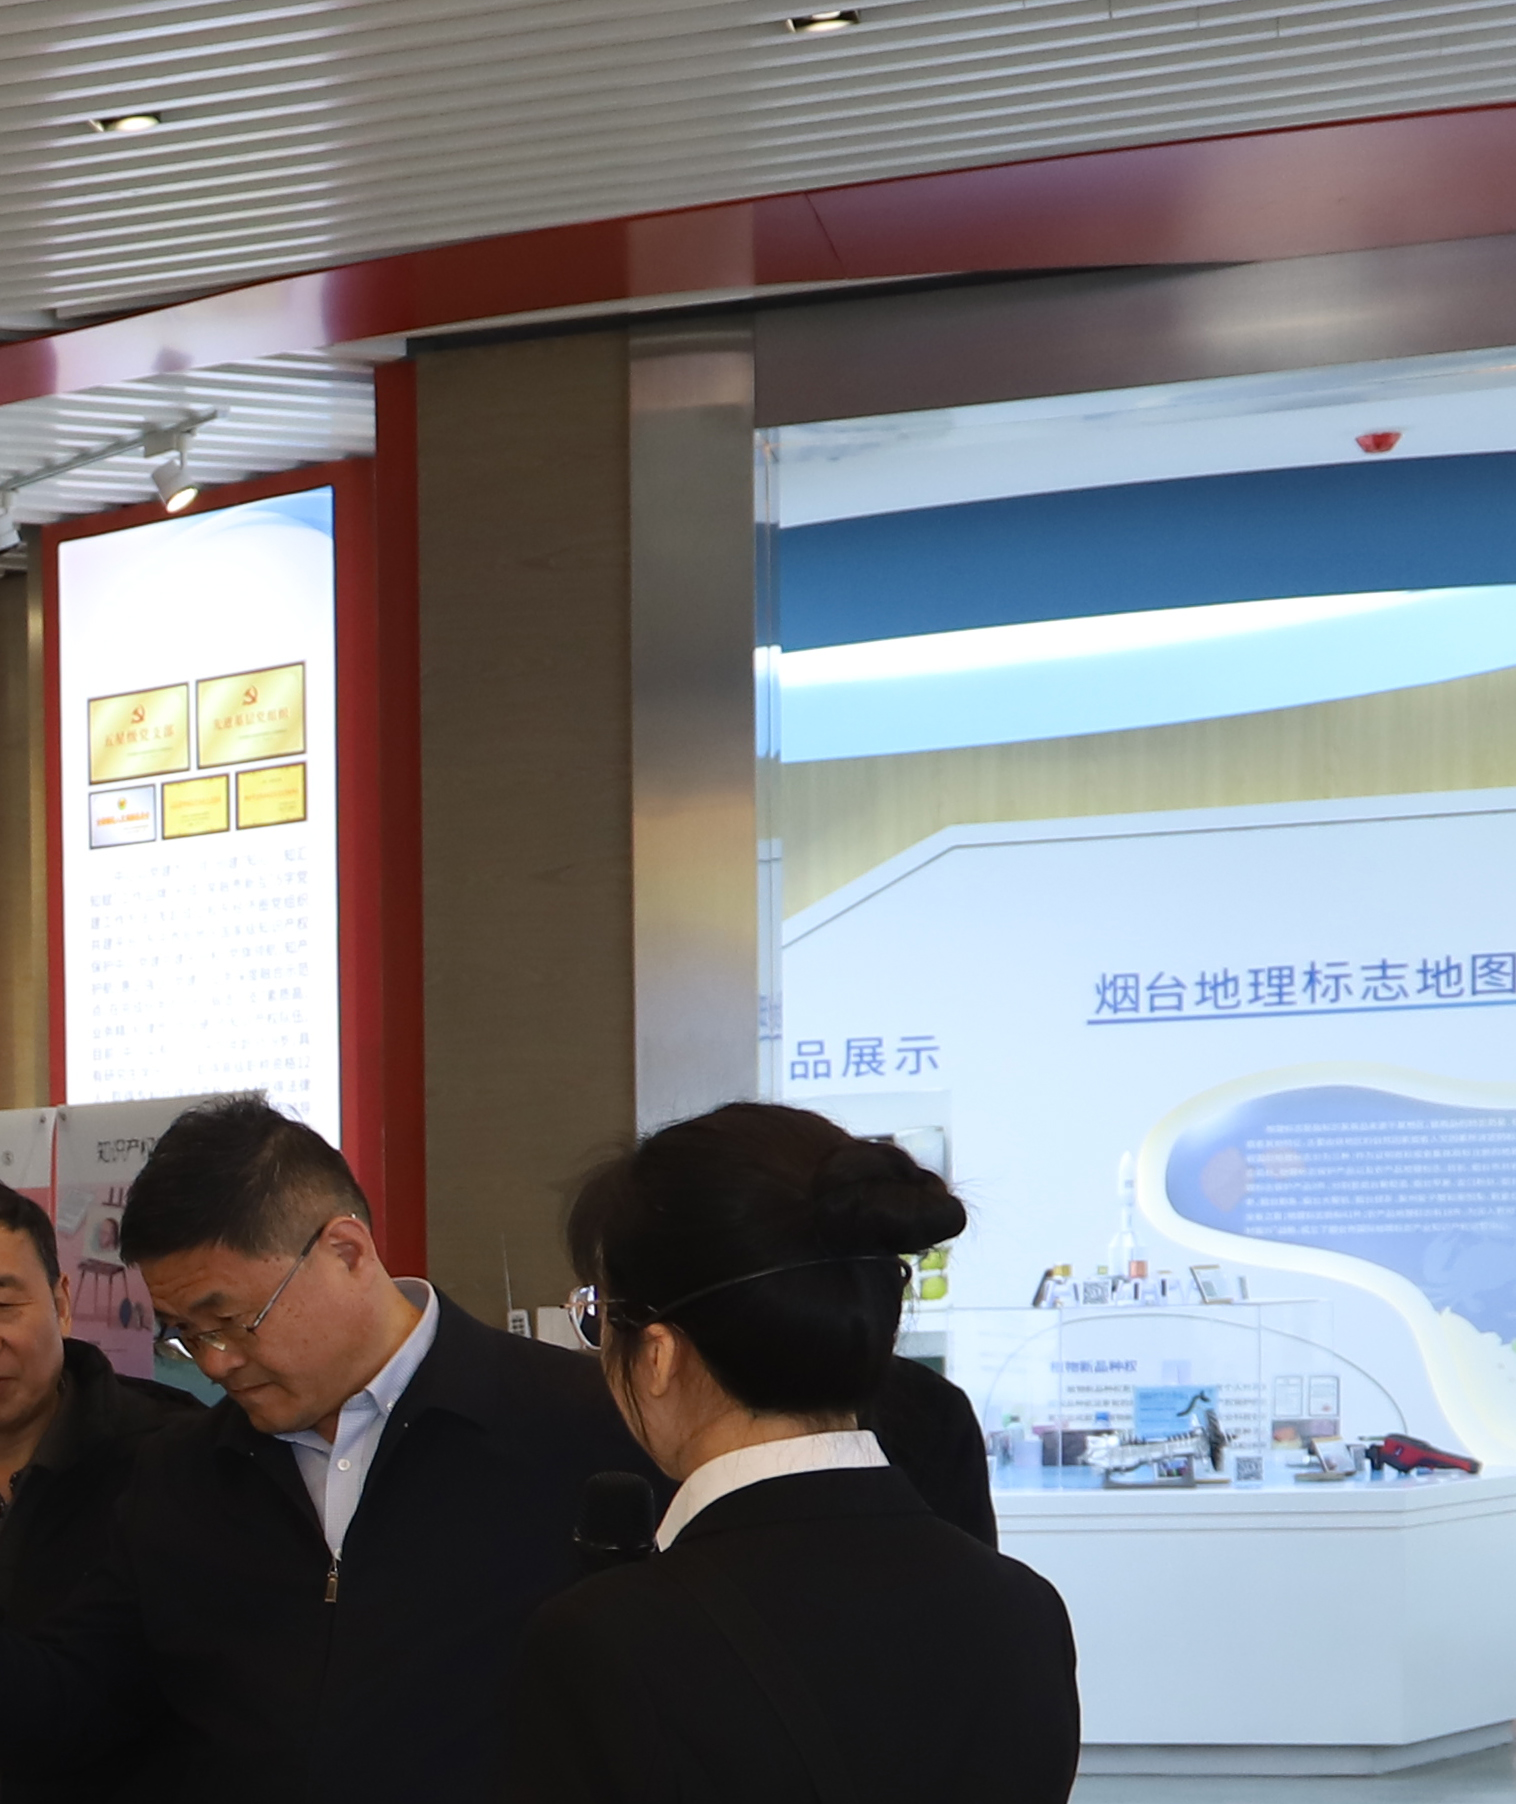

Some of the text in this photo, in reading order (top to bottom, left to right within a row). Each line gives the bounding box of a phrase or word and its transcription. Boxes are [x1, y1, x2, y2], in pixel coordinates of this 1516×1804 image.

[1095, 952, 1516, 1015] 烟台地理标志地图
[790, 1035, 940, 1081] 品展示
